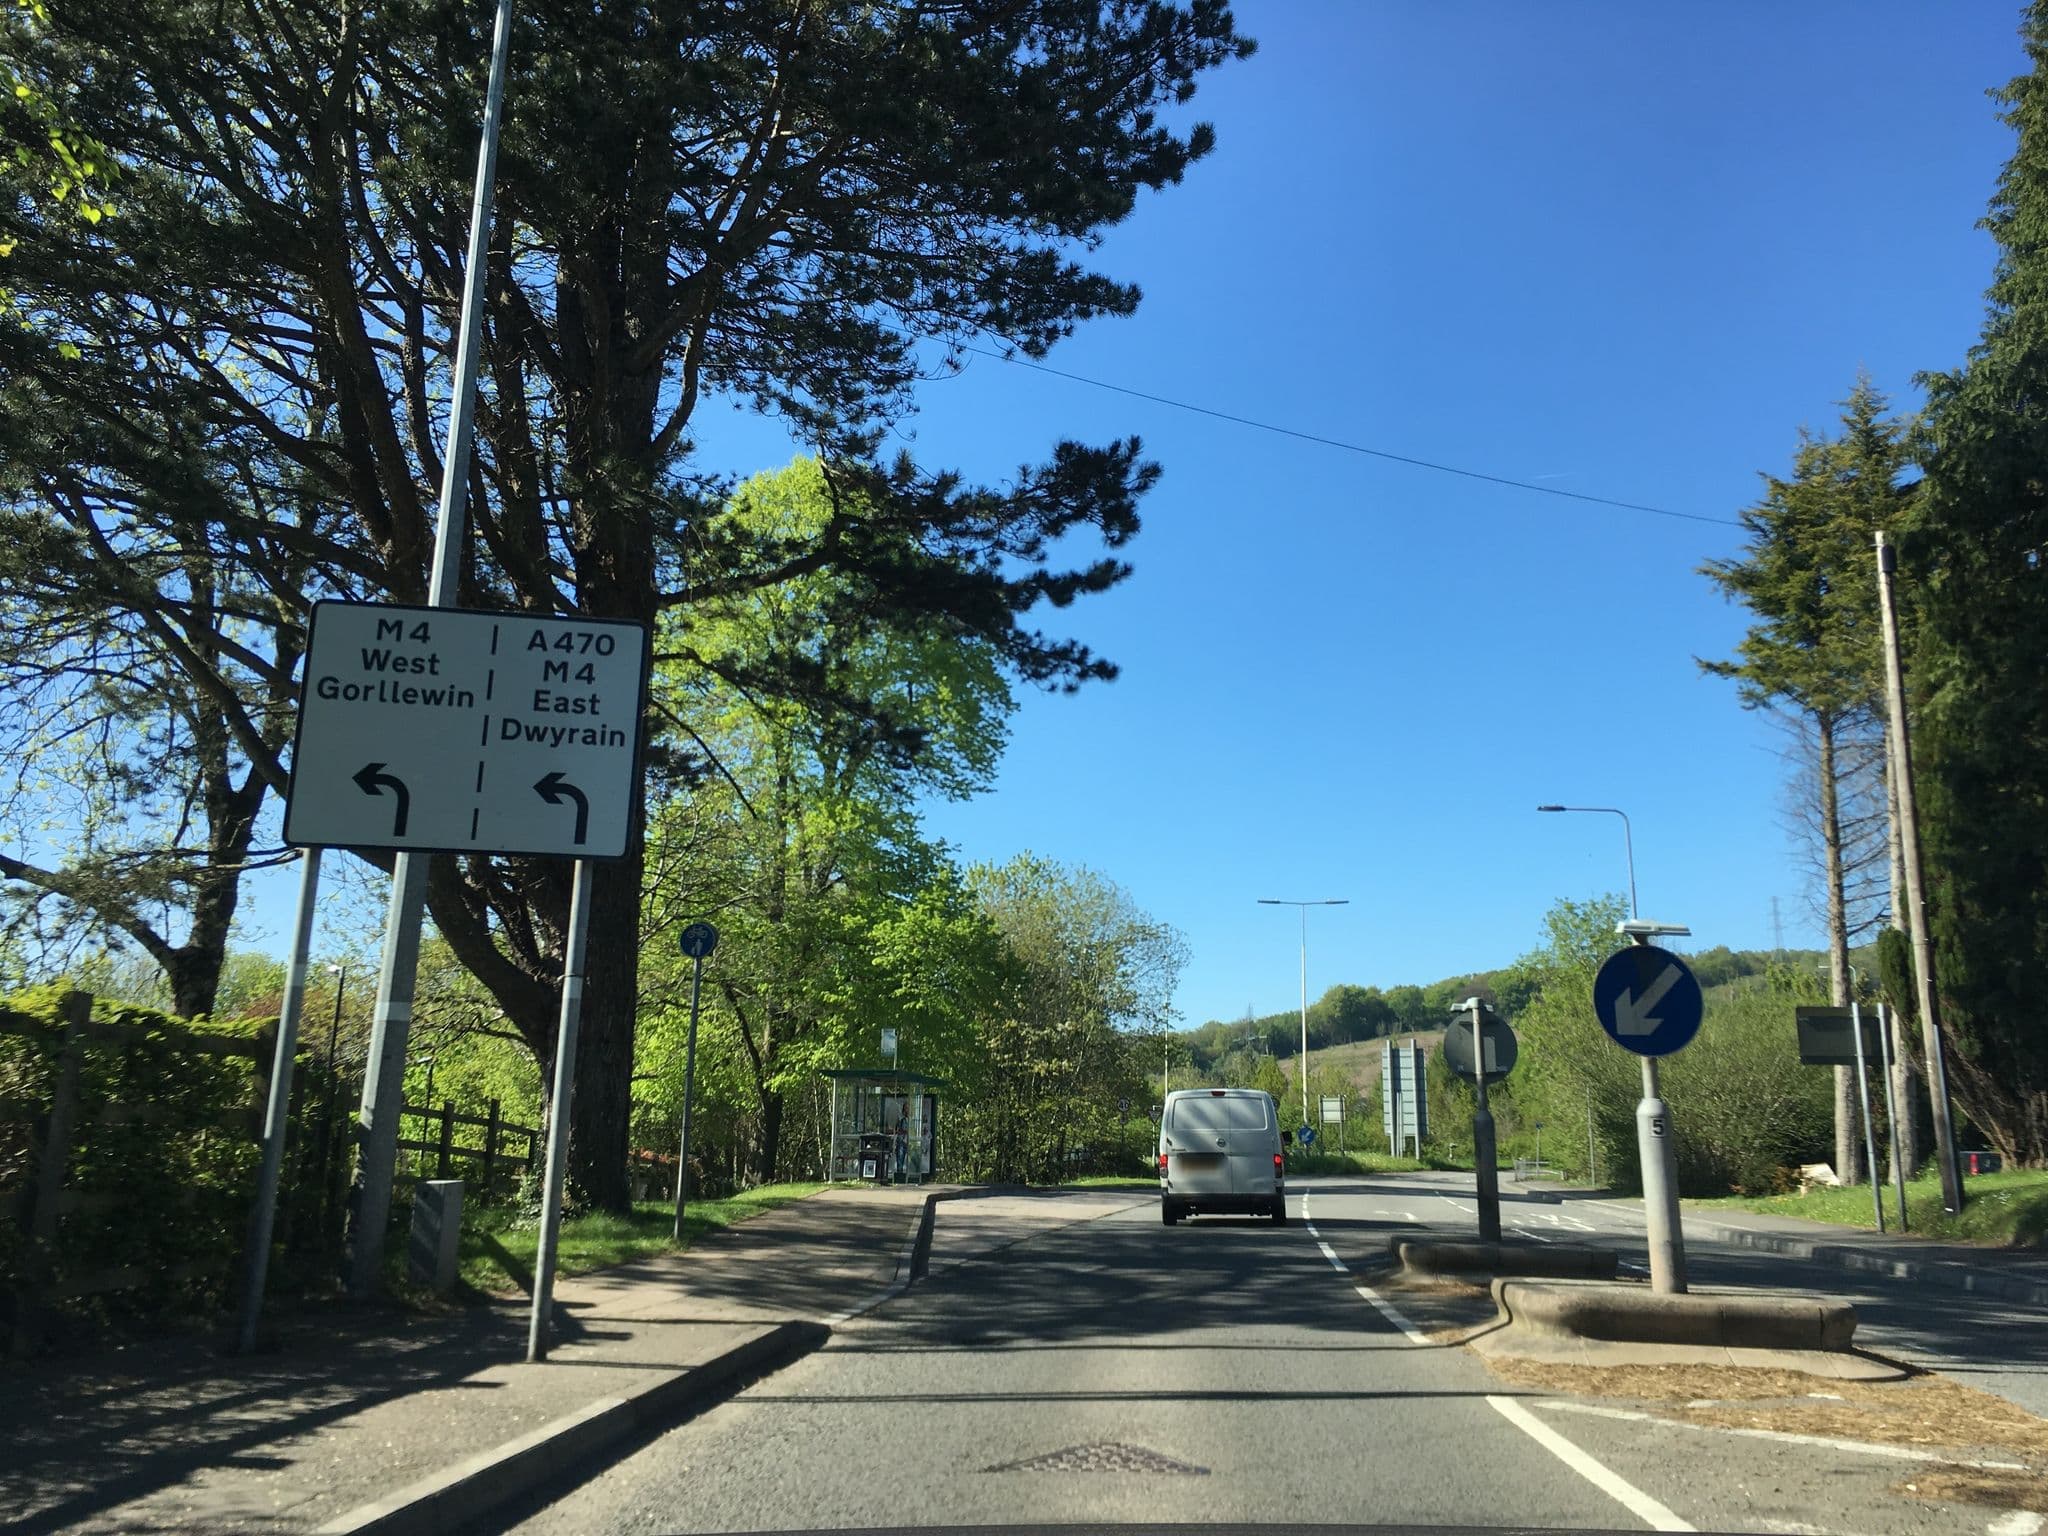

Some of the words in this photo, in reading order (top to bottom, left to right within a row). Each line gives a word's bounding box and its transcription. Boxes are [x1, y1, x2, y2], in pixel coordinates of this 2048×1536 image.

[527, 629, 616, 656] A470
[362, 648, 440, 675] West
[317, 676, 474, 708] Gorllewin
[533, 690, 600, 715] East
[500, 718, 626, 748] Dwyrain
[1653, 1119, 1664, 1135] 5
